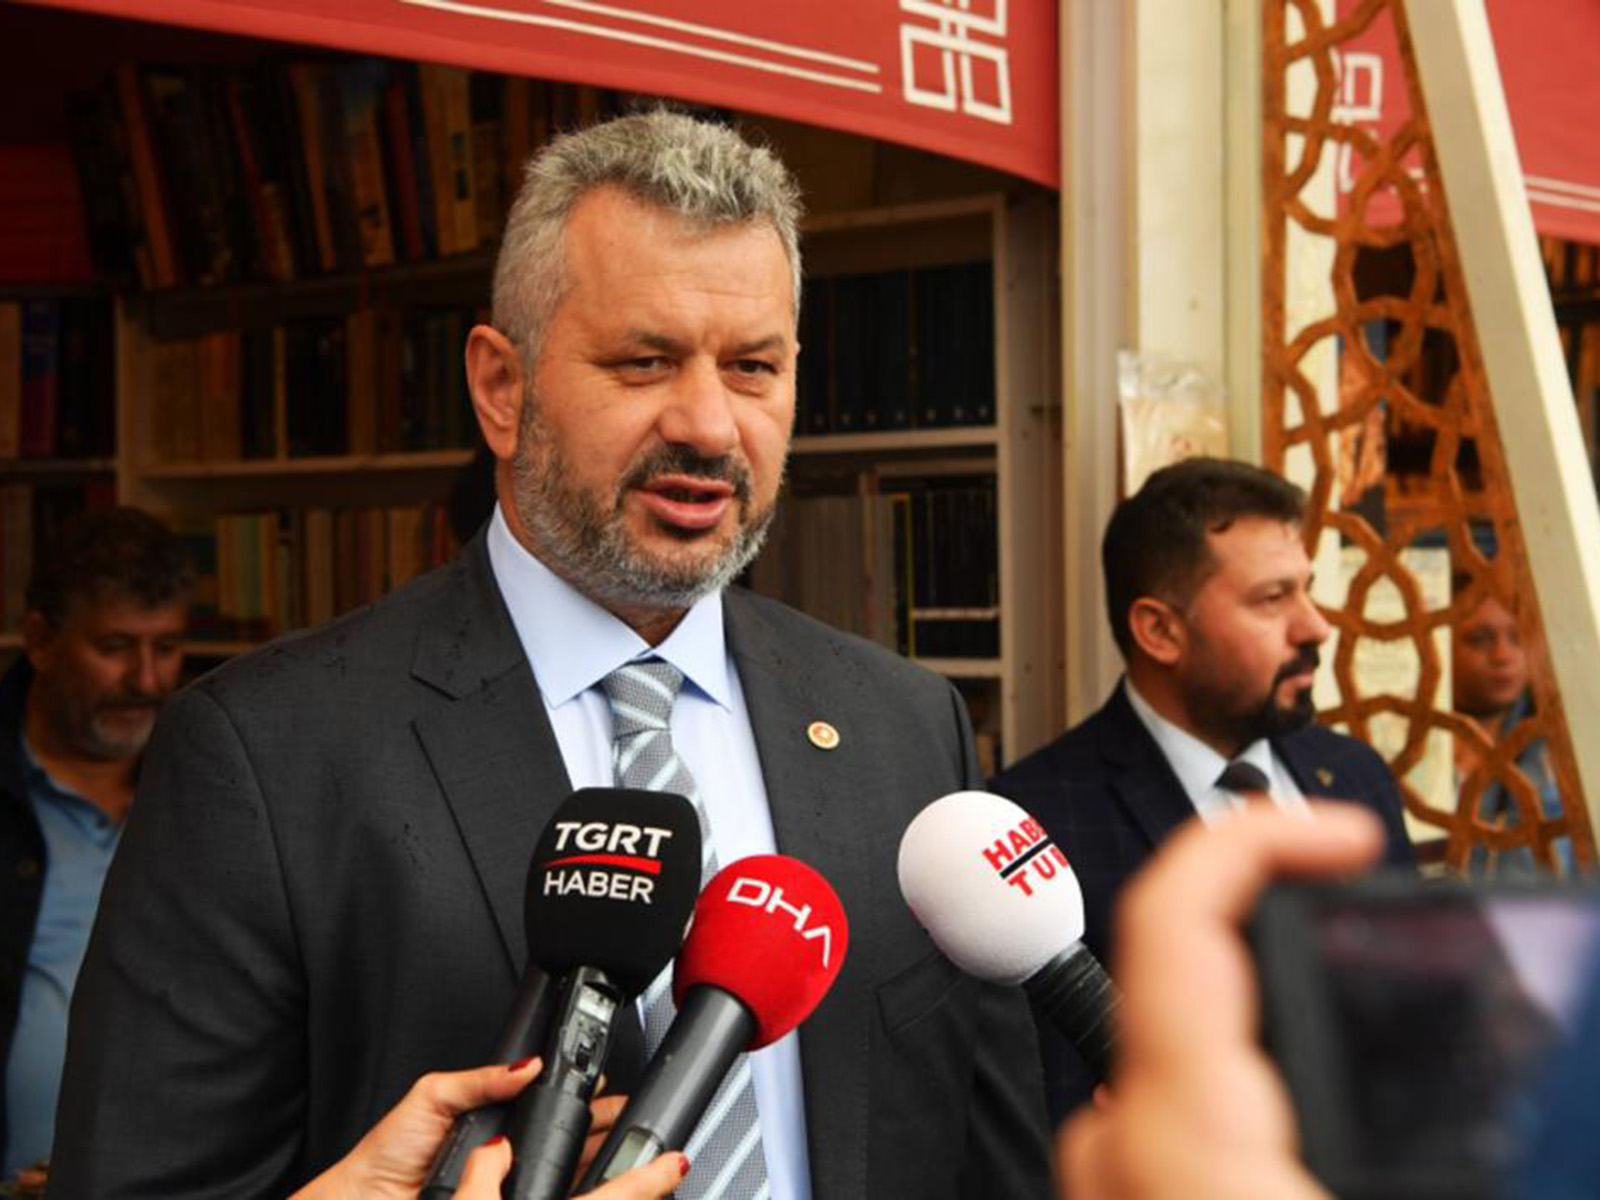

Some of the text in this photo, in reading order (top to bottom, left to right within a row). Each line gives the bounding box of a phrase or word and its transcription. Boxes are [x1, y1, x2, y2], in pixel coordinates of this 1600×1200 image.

[554, 822, 673, 858] TGRT
[543, 871, 654, 904] HABER
[726, 877, 831, 970] DHA
